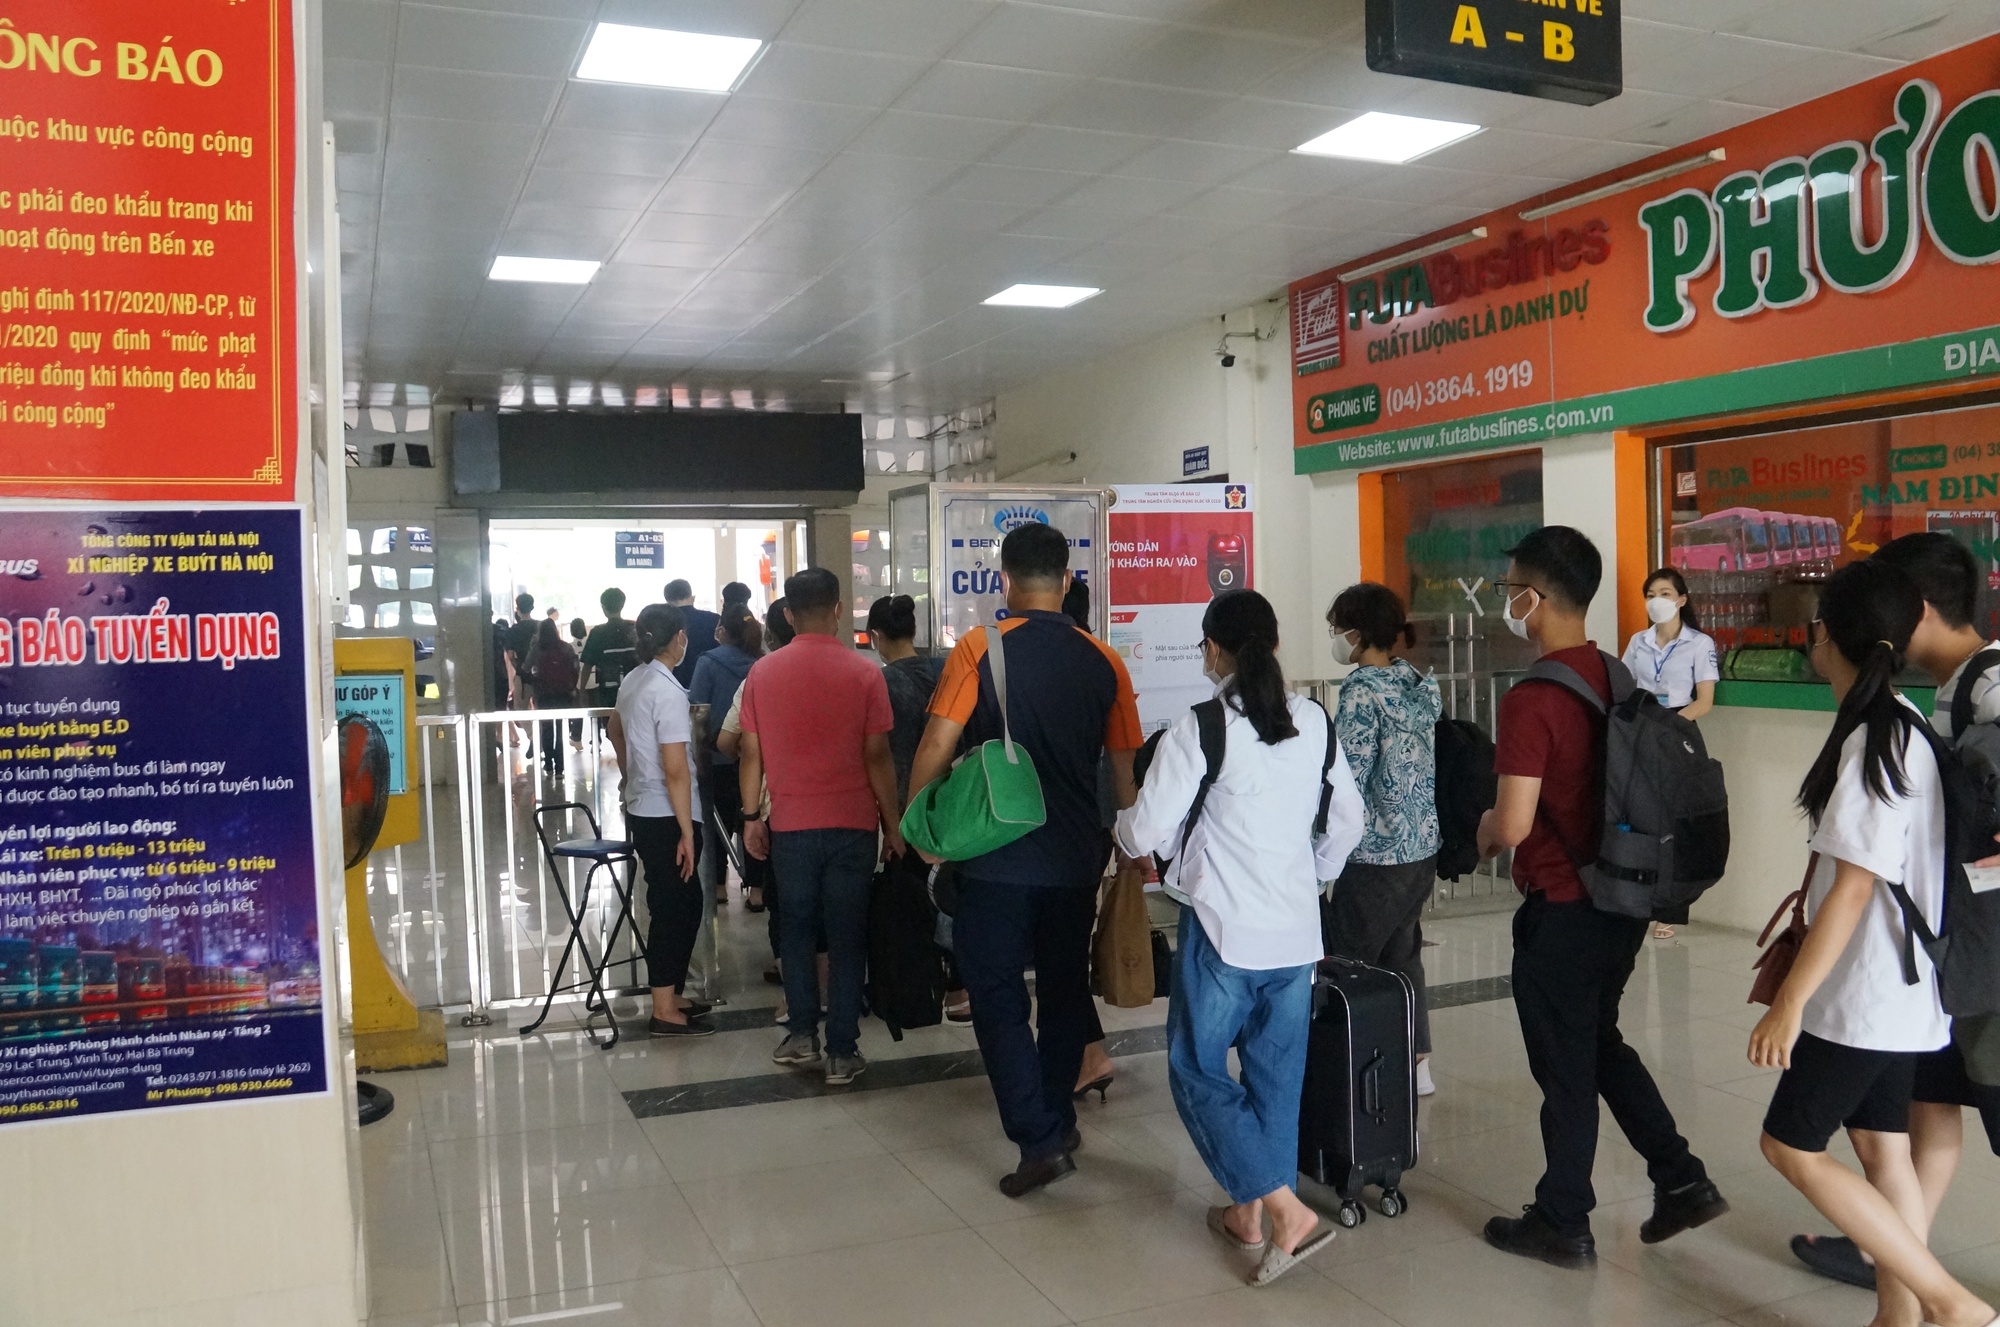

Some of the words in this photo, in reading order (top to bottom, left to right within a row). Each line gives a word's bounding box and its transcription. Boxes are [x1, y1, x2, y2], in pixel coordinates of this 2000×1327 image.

[1450, 4, 1487, 49] A
[1505, 31, 1524, 42] -
[1543, 20, 1575, 63] B
[117, 36, 223, 87] BÁO
[47, 118, 87, 142] khu
[95, 124, 135, 149] vực
[142, 126, 194, 154] công
[202, 130, 252, 157] cộng
[18, 187, 63, 214] phải
[70, 191, 107, 214] đeo
[114, 190, 161, 217] khẩu
[168, 198, 218, 224] trang
[225, 200, 253, 221] khi
[45, 228, 95, 256] động
[102, 230, 141, 253] trên
[149, 230, 185, 255] Bến
[192, 239, 214, 256] xe
[35, 288, 74, 314] định
[80, 290, 233, 319] 117/2020/NĐ-CP,
[239, 295, 256, 317] từ
[1368, 322, 1409, 364] CHẤT
[1413, 316, 1470, 354] LƯỢNG
[1473, 304, 1498, 338] LÀ
[1501, 292, 1554, 332] DANH
[1559, 279, 1591, 321] DỰ
[69, 331, 101, 353] quy
[112, 328, 150, 355] định
[219, 331, 256, 358] phạt
[41, 361, 85, 392] đồng
[90, 365, 116, 387] khi
[122, 366, 174, 393] không
[179, 366, 211, 390] đeo
[216, 364, 256, 390] khẩu
[1328, 393, 1361, 420] PHÒNG
[1386, 381, 1422, 416] (04)
[1485, 360, 1533, 394] 1919
[12, 401, 57, 428] công
[1339, 440, 1395, 461] Website:
[1861, 480, 1928, 507] NAM
[81, 531, 114, 549] TỔNG
[117, 530, 151, 548] CÔNG
[153, 534, 168, 547] TY
[170, 531, 195, 549] VẬN
[197, 530, 216, 546] TẢI
[219, 531, 236, 546] HÀ
[238, 531, 259, 548] NỘI
[638, 534, 663, 542] A1-03
[67, 554, 85, 574] XÍ
[88, 553, 149, 576] NGHIỆP
[152, 556, 174, 573] XE
[177, 552, 216, 573] BUÝT
[221, 551, 243, 571] HÀ
[246, 551, 273, 574] NỘI
[1118, 556, 1154, 568] KHÁCH
[1176, 555, 1198, 568] VÀO
[952, 561, 1003, 595] CỬA
[19, 608, 86, 667] BÁO
[91, 597, 191, 664] TUYỂN
[195, 612, 280, 671] DỤNG
[352, 684, 378, 701] GÓP
[382, 684, 390, 700] Ý
[6, 700, 31, 717] tục
[34, 697, 77, 717] tuyển
[80, 698, 120, 715] dụng
[17, 721, 56, 740] buýt
[58, 718, 100, 738] bằng
[102, 719, 129, 735] E,D
[15, 744, 51, 759] viên
[53, 743, 94, 762] phục
[96, 744, 117, 759] vụ
[16, 765, 50, 780] kinh
[52, 763, 110, 783] nghiệm
[113, 762, 140, 777] bus
[143, 760, 158, 775] đi
[160, 760, 187, 774] làm
[190, 761, 226, 776] ngay
[5, 788, 45, 804] được
[47, 785, 77, 801] đào
[80, 786, 104, 801] tạo
[106, 781, 159, 799] nhanh,
[161, 779, 181, 796] bố
[183, 779, 199, 794] trí
[202, 782, 216, 793] ra
[219, 776, 259, 795] tuyến
[262, 776, 294, 791] luôn
[29, 824, 51, 843] lợi
[53, 821, 101, 841] người
[103, 820, 129, 836] lao
[130, 819, 177, 837] động:
[45, 845, 81, 861] Trên
[83, 845, 95, 859] 8
[96, 842, 135, 860] triệu
[147, 841, 166, 855] 13
[168, 838, 206, 856] triệu
[40, 868, 75, 884] viên
[78, 865, 118, 884] phục
[146, 862, 164, 876] từ
[166, 861, 177, 875] 6
[179, 859, 216, 877] triệu
[227, 858, 237, 872] 9
[240, 856, 276, 873] triệu
[104, 885, 129, 900] Đãi
[132, 883, 161, 900] ngộ
[164, 881, 201, 900] phúc
[203, 879, 221, 896] lợi
[224, 877, 258, 893] khác
[5, 913, 34, 928] làm
[37, 911, 69, 929] việc
[71, 907, 125, 926] chuyên
[127, 903, 179, 924] nghiệp
[182, 901, 199, 917] và
[202, 899, 230, 919] gắn
[232, 896, 255, 913] kết
[20, 1042, 68, 1059] nghiệp:
[69, 1039, 109, 1053] Phòng
[110, 1035, 143, 1049] Hành
[145, 1031, 178, 1045] chính
[178, 1029, 210, 1042] Nhân
[263, 1024, 271, 1034] 2
[15, 1060, 35, 1072] Lạc
[37, 1057, 73, 1070] Trung,
[126, 1048, 145, 1060] Hai
[145, 1075, 167, 1088] Tel:
[168, 1068, 247, 1085] 0243.971.1816
[146, 1090, 164, 1101] Mr
[165, 1084, 215, 1099] Phương:
[216, 1077, 293, 1095] 098.930.6666
